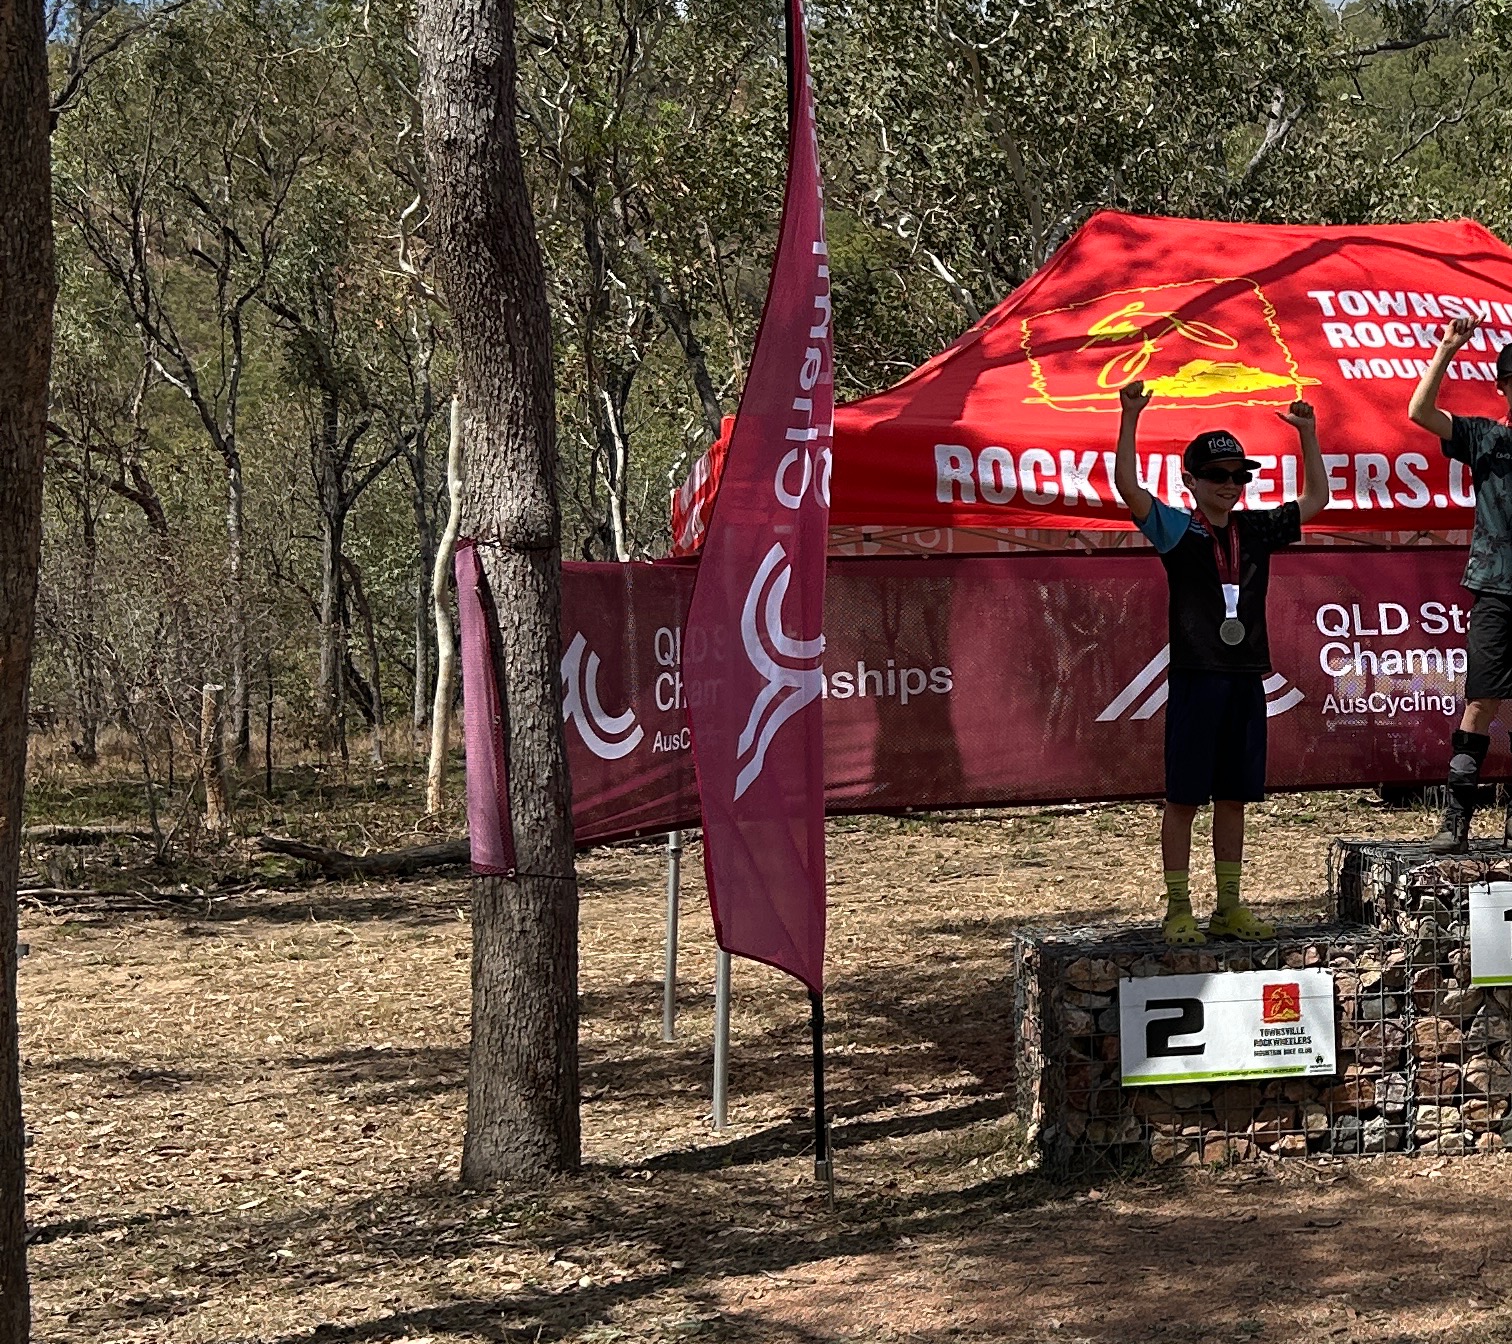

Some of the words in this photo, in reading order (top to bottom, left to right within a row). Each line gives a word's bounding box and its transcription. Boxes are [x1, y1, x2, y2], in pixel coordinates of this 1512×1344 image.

[1315, 602, 1410, 639] QLD
[1321, 690, 1457, 718] AusCycling
[1145, 997, 1207, 1059] 2
